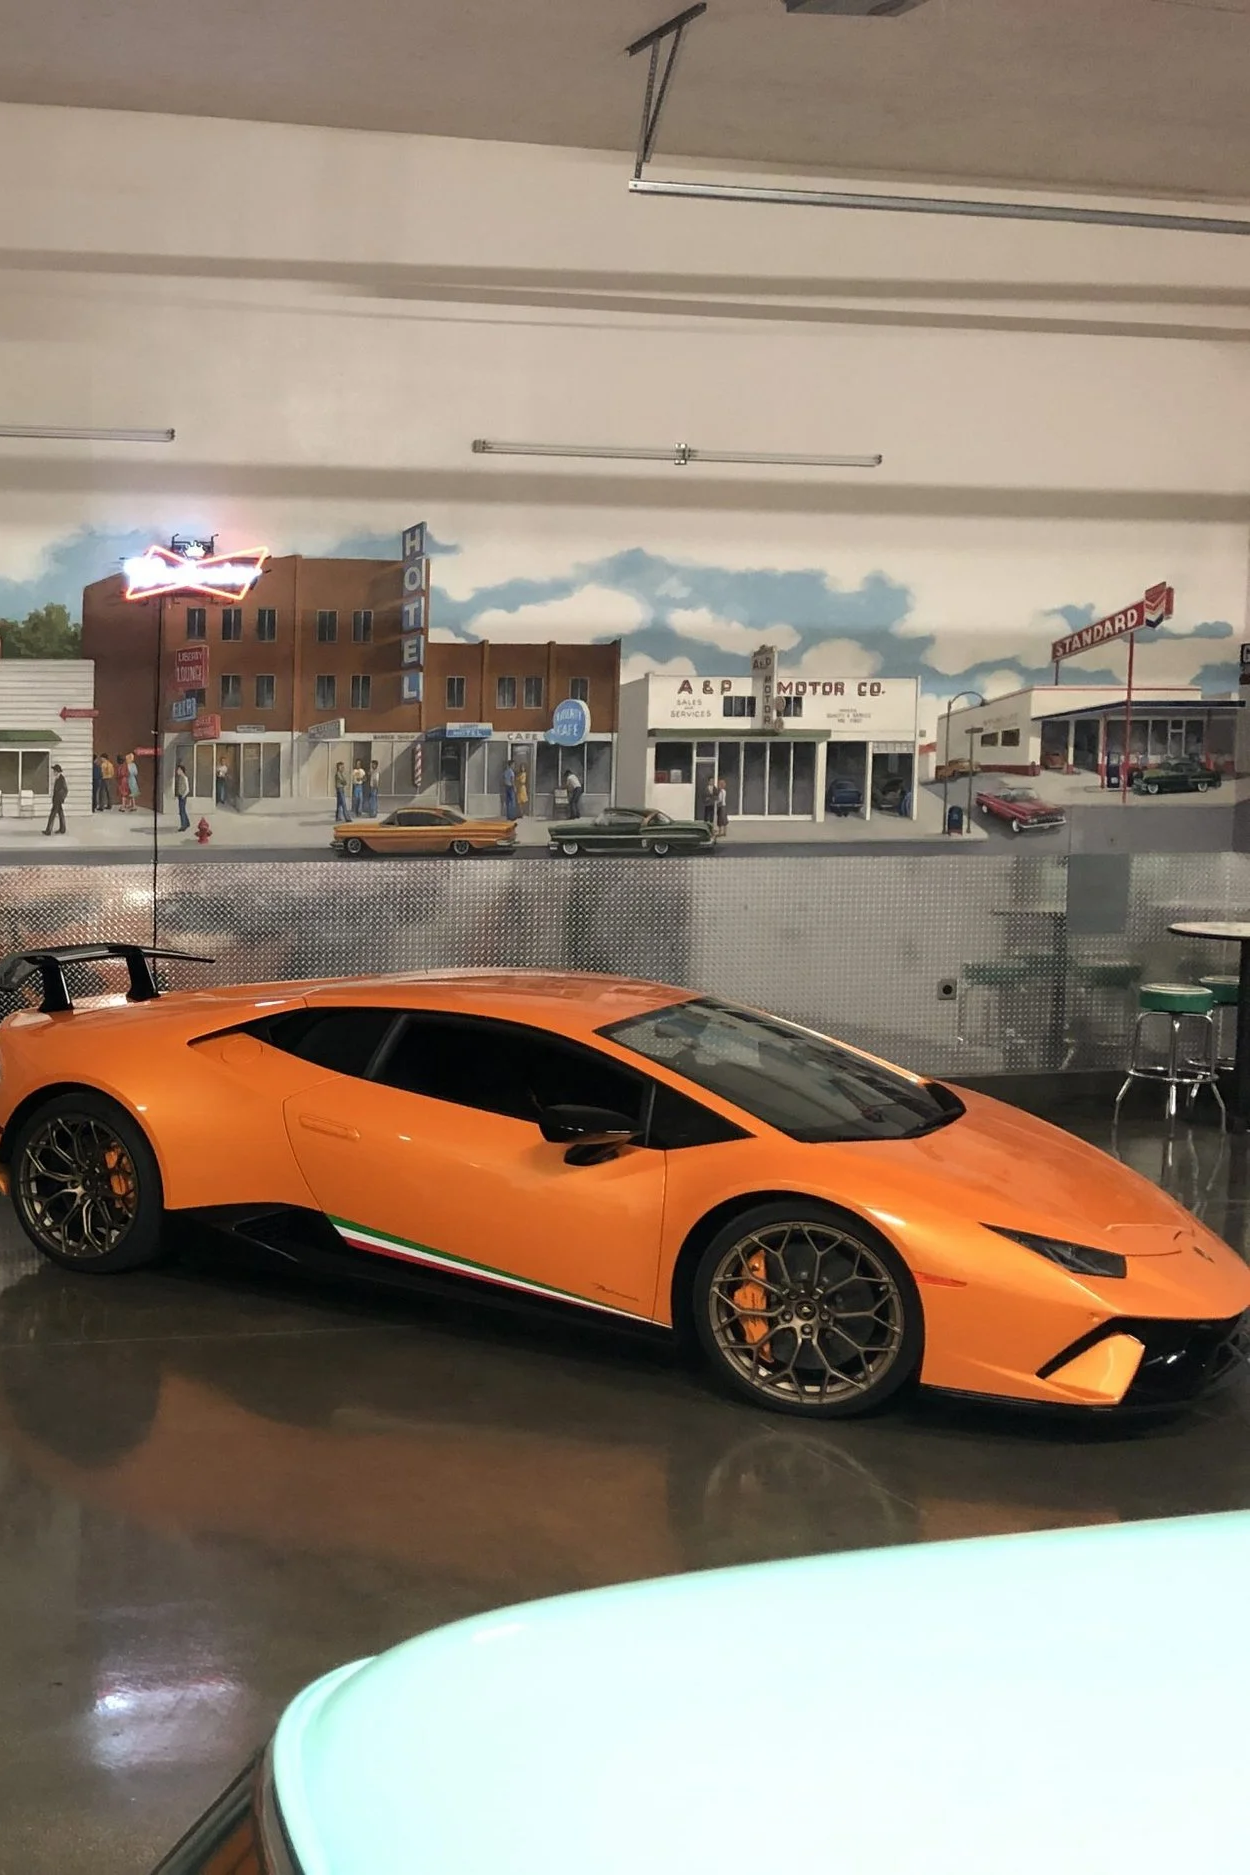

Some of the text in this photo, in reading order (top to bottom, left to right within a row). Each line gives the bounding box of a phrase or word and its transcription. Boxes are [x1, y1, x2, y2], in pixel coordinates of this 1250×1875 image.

[403, 528, 421, 700] HOTEL
[1055, 609, 1138, 657] STANDARD
[677, 680, 693, 694] A
[702, 681, 714, 694] &
[777, 681, 845, 696] MOTOR
[857, 682, 886, 697] CO.
[670, 710, 712, 718] SERVICES
[507, 732, 539, 741] CAFE
